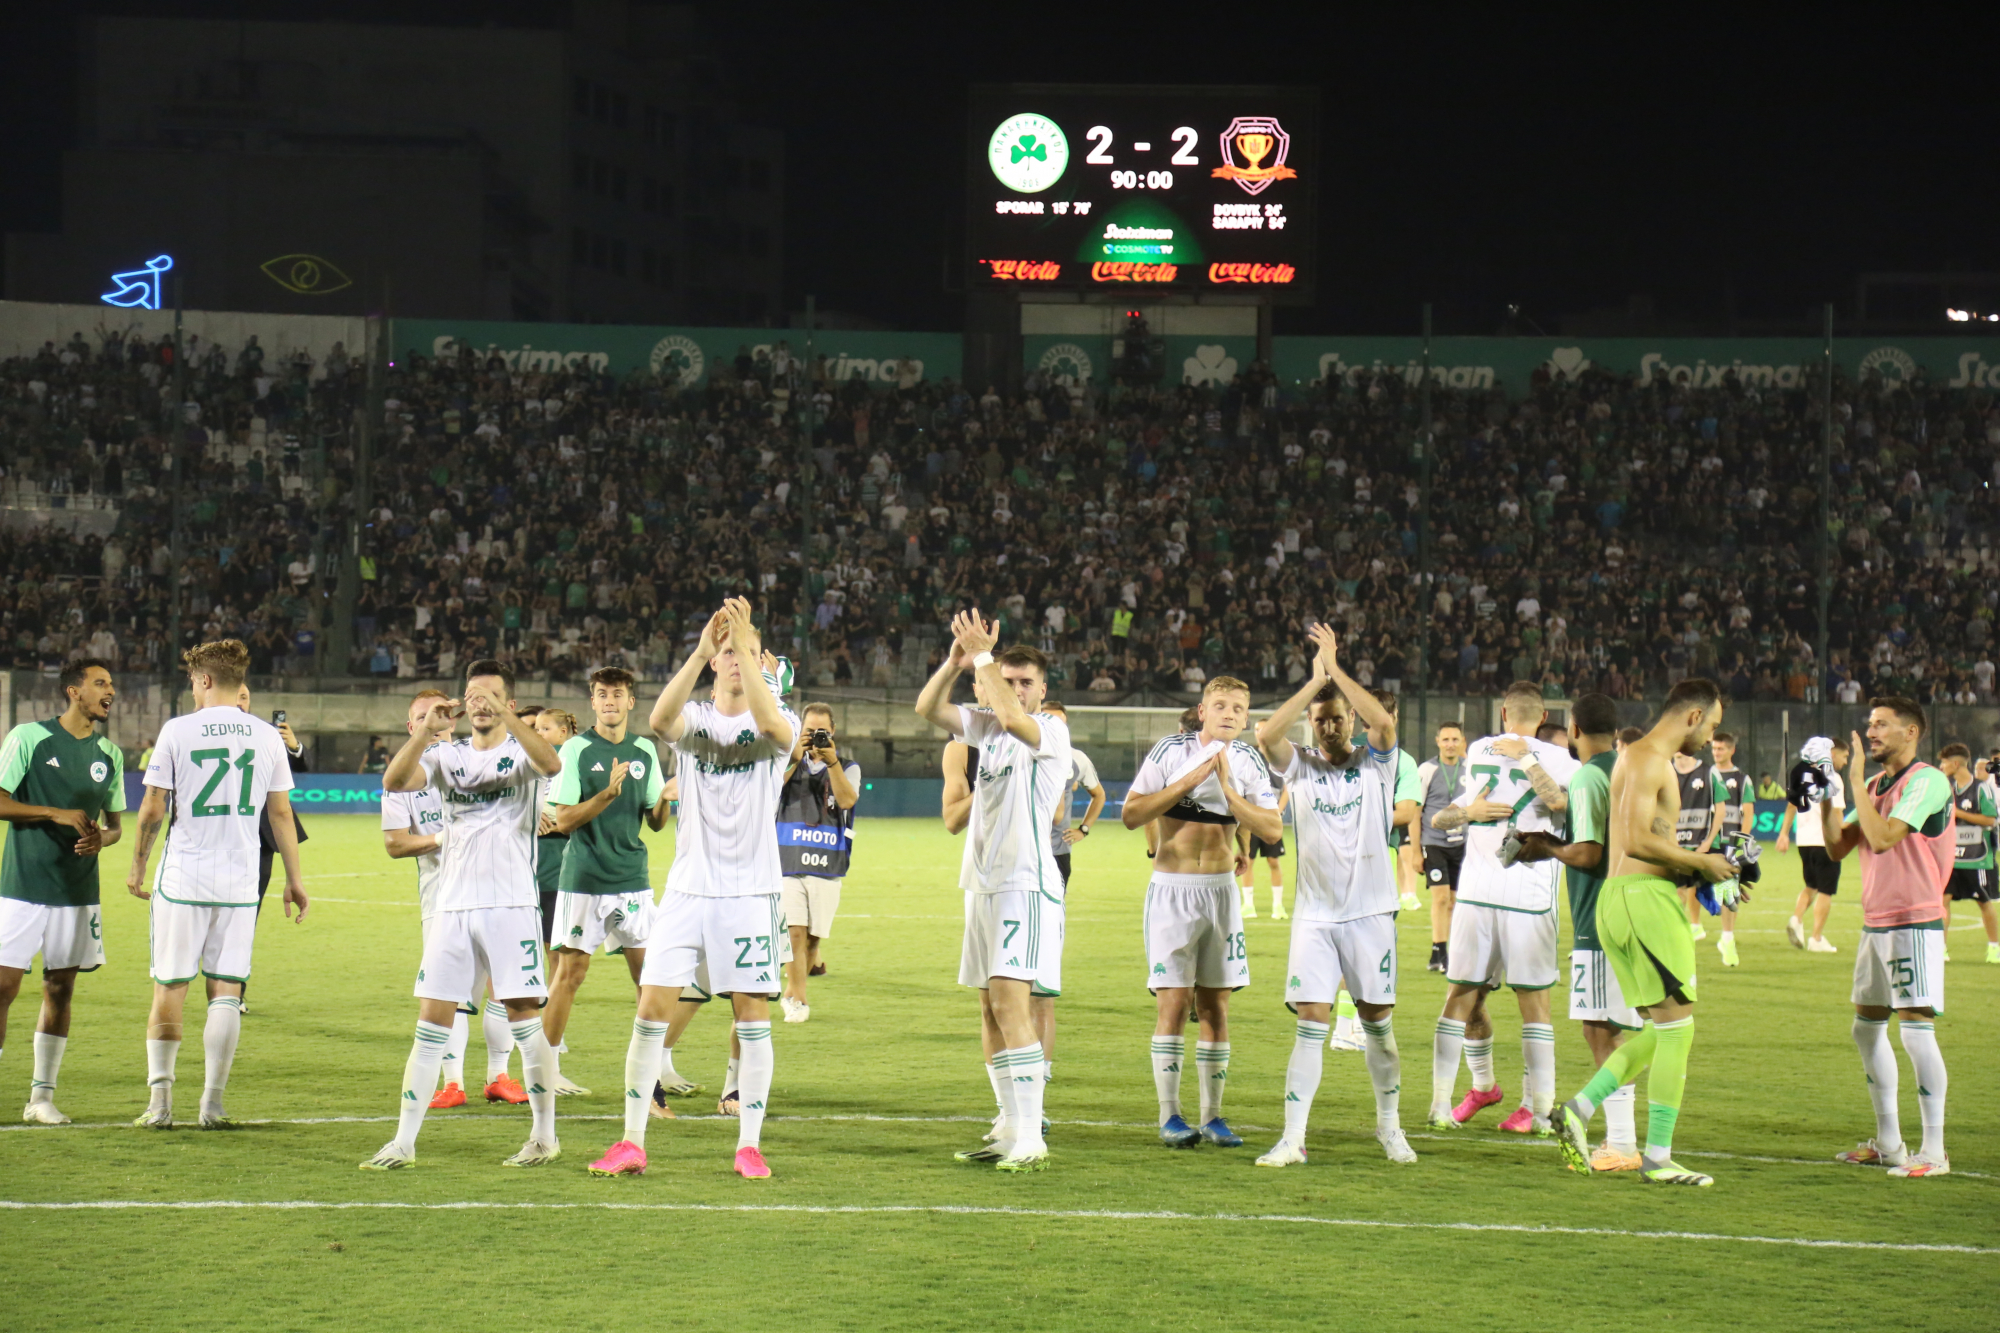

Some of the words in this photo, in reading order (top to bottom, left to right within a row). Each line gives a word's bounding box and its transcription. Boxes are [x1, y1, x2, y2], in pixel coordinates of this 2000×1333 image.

[1086, 125, 1114, 164] 2
[1170, 126, 1199, 166] 2
[1110, 170, 1173, 189] 90:00
[201, 723, 252, 737] JEDVAJ
[190, 748, 256, 817] 21
[792, 828, 838, 846] PHOTO
[801, 852, 829, 868] 004
[1002, 919, 1021, 949] 7
[1226, 931, 1247, 961] 18
[519, 939, 539, 971] 3
[733, 935, 772, 969] 23
[1379, 948, 1392, 979] 4
